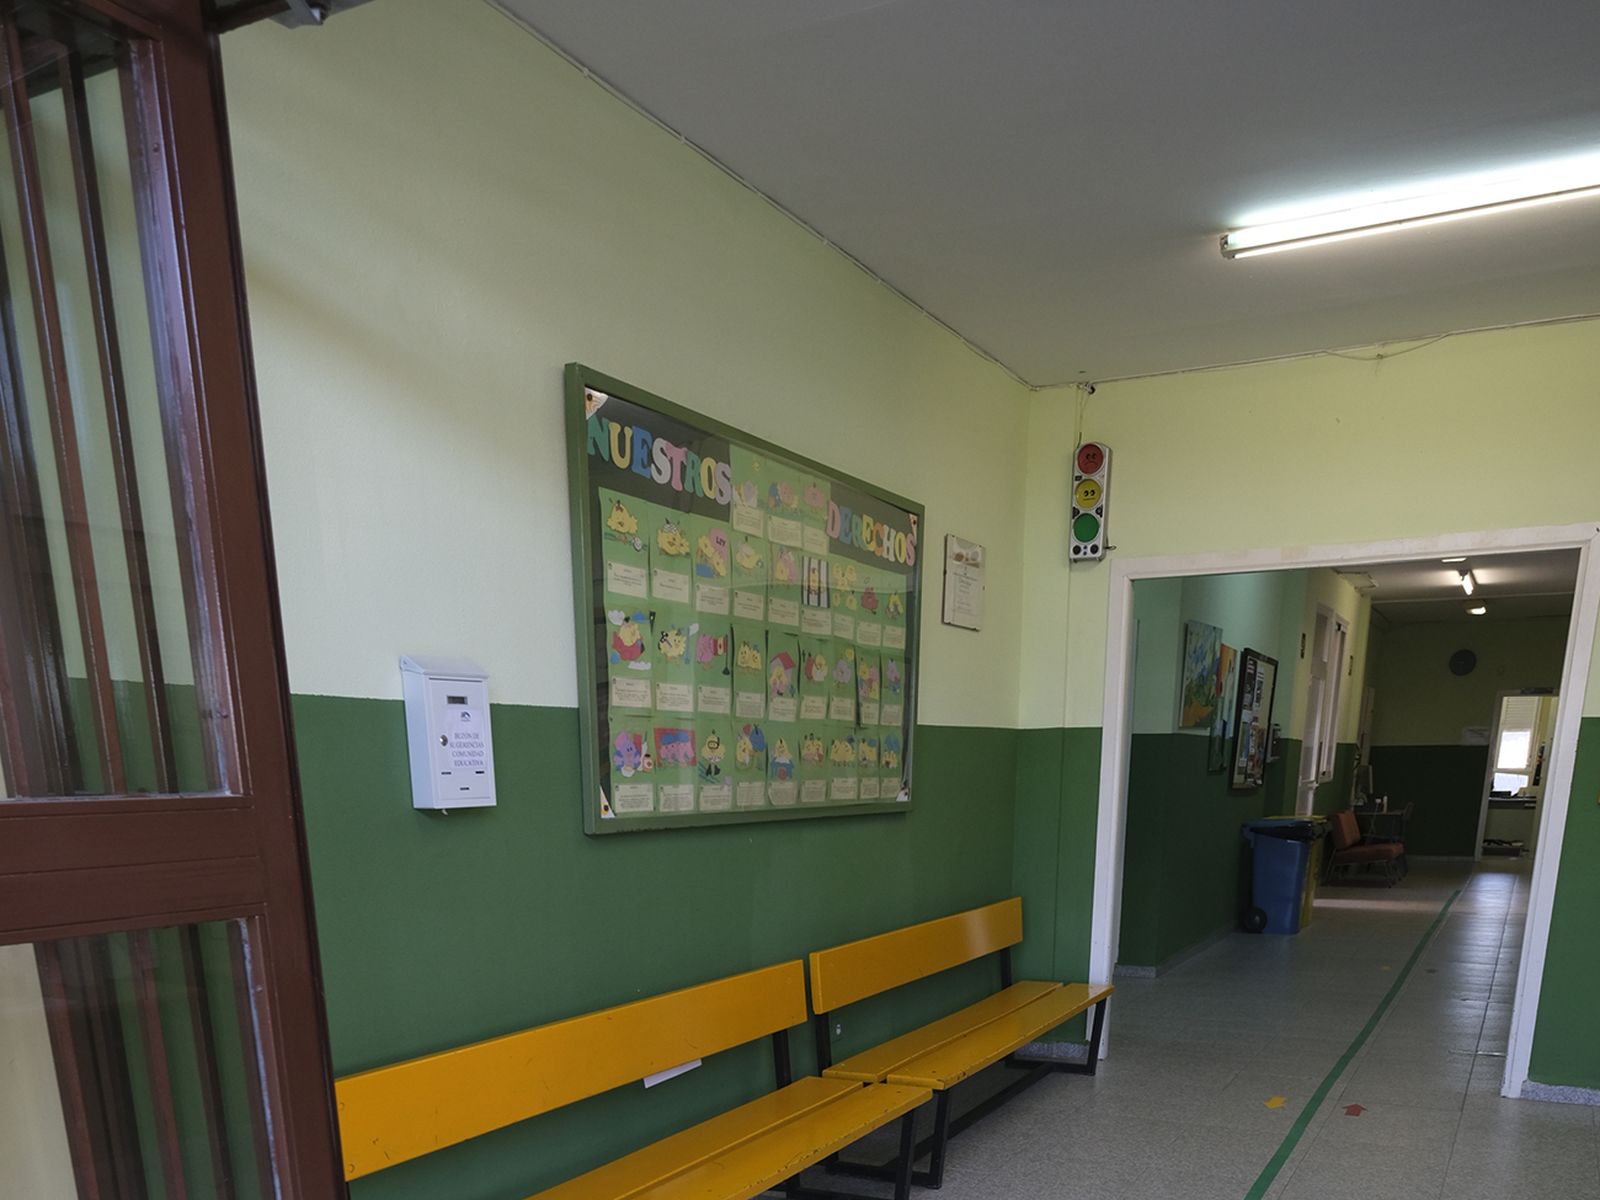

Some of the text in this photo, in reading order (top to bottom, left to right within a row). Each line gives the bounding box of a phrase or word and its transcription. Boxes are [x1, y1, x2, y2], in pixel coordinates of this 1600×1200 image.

[586, 415, 732, 505] NUESTROS
[826, 500, 917, 566] DERECHOS
[454, 759, 484, 767] EDUCATIVA
